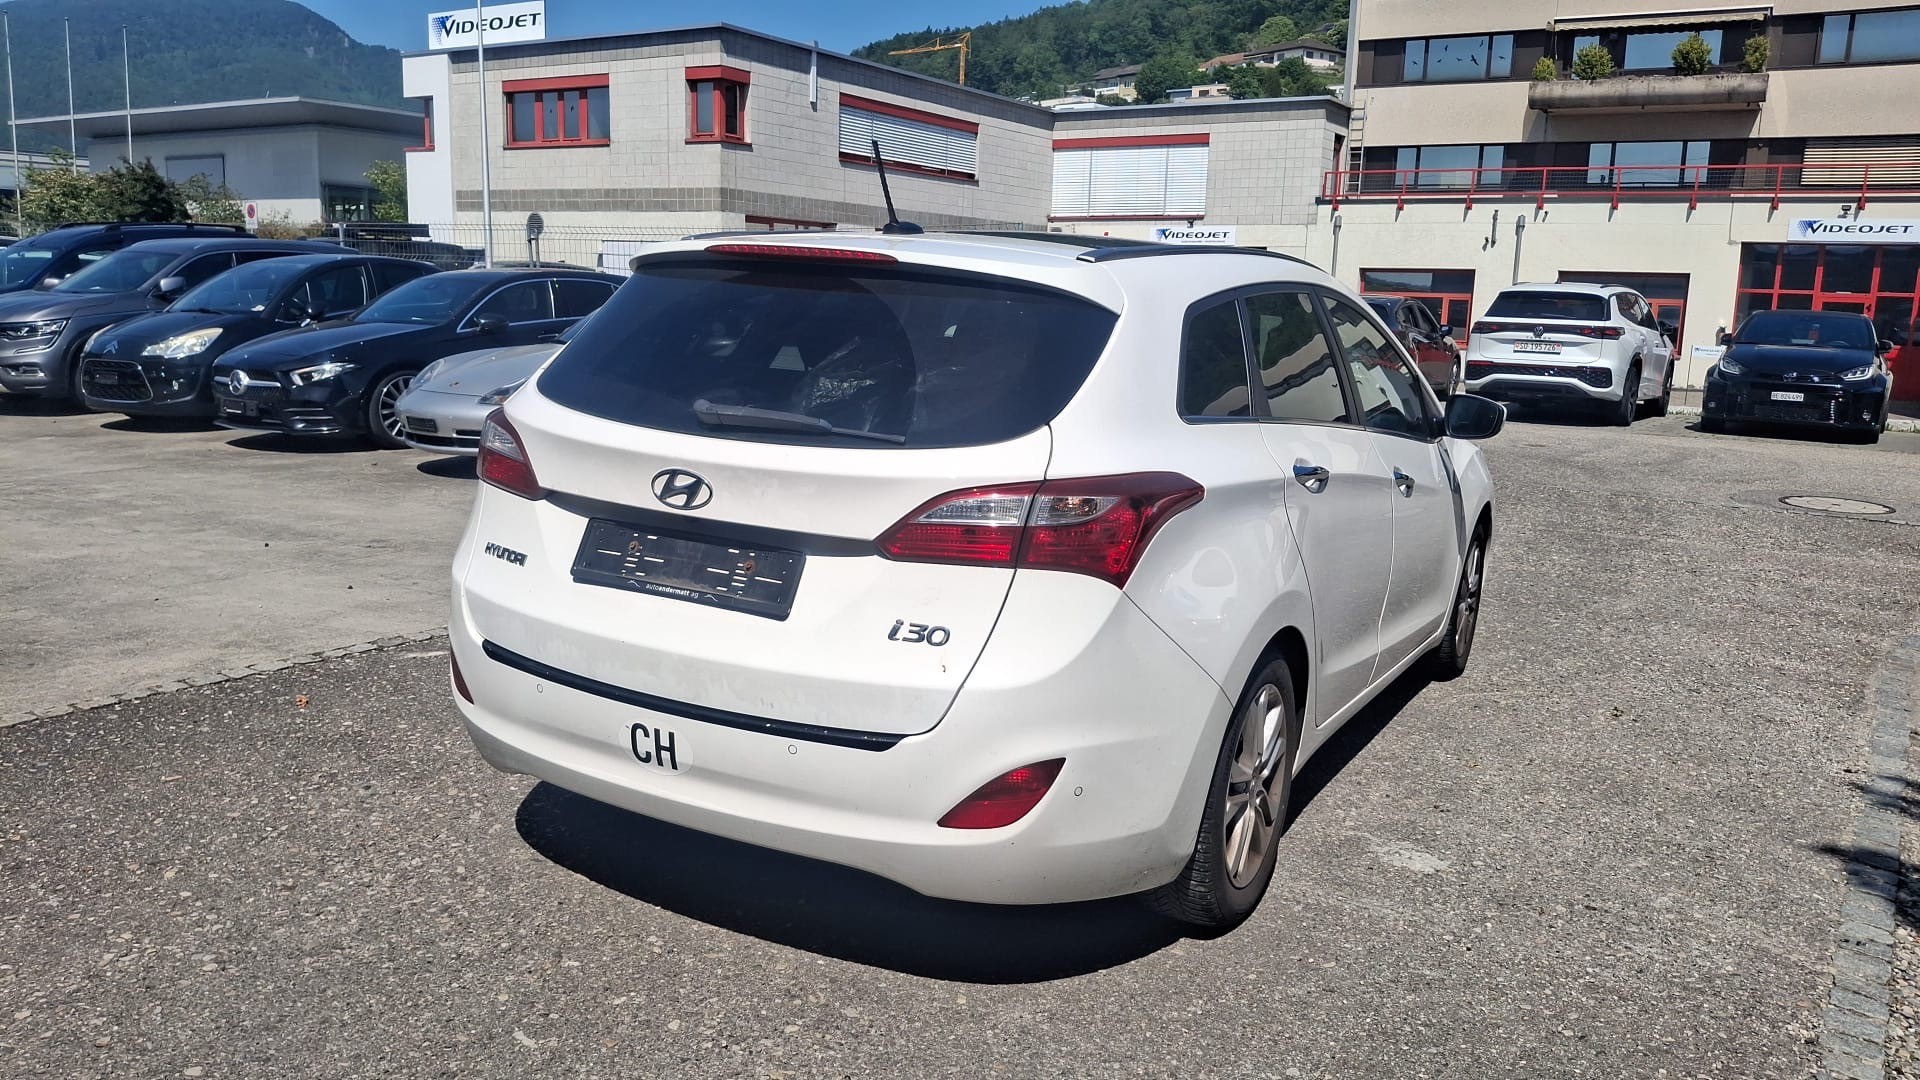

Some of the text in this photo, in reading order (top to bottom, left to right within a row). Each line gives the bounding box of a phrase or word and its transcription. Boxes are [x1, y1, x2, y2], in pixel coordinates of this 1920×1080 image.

[438, 13, 542, 39] VIDEOJET
[1160, 228, 1230, 240] VIDEOJET
[1806, 220, 1914, 235] VIDEOJET
[485, 541, 528, 567] HYUNDAI
[645, 583, 699, 599] autoandermatt ag
[887, 618, 951, 646] i30
[631, 722, 678, 771] CH
